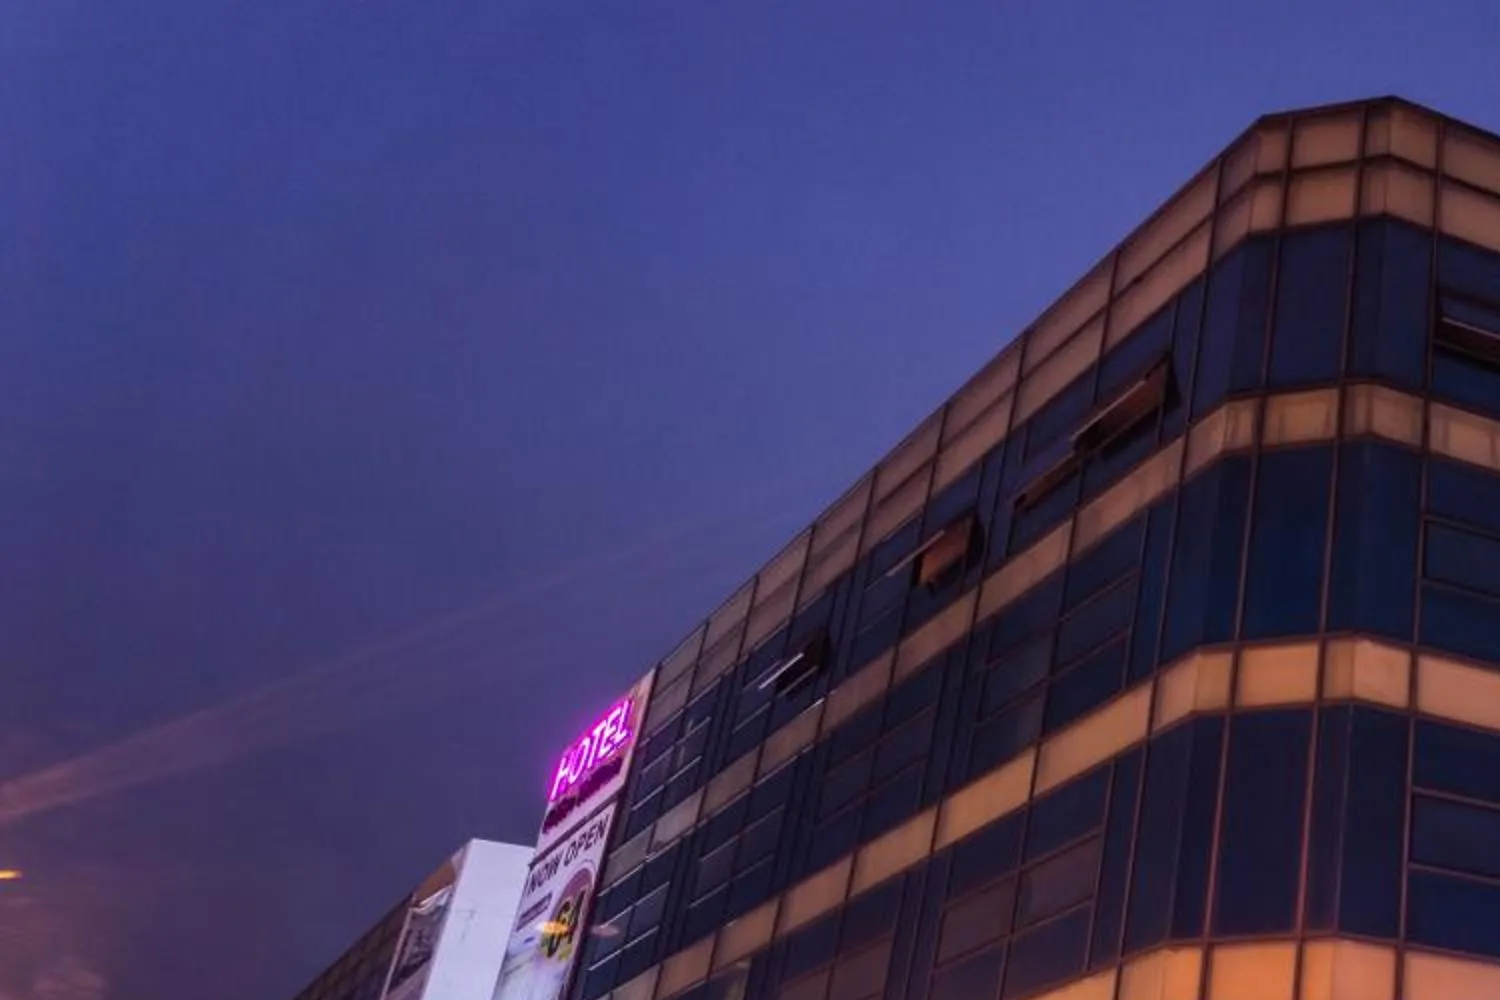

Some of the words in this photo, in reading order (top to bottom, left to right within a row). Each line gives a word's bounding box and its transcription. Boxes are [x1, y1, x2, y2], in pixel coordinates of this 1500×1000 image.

[551, 699, 635, 800] HOTEL
[527, 855, 562, 896] NOW
[564, 813, 610, 867] OPEN
